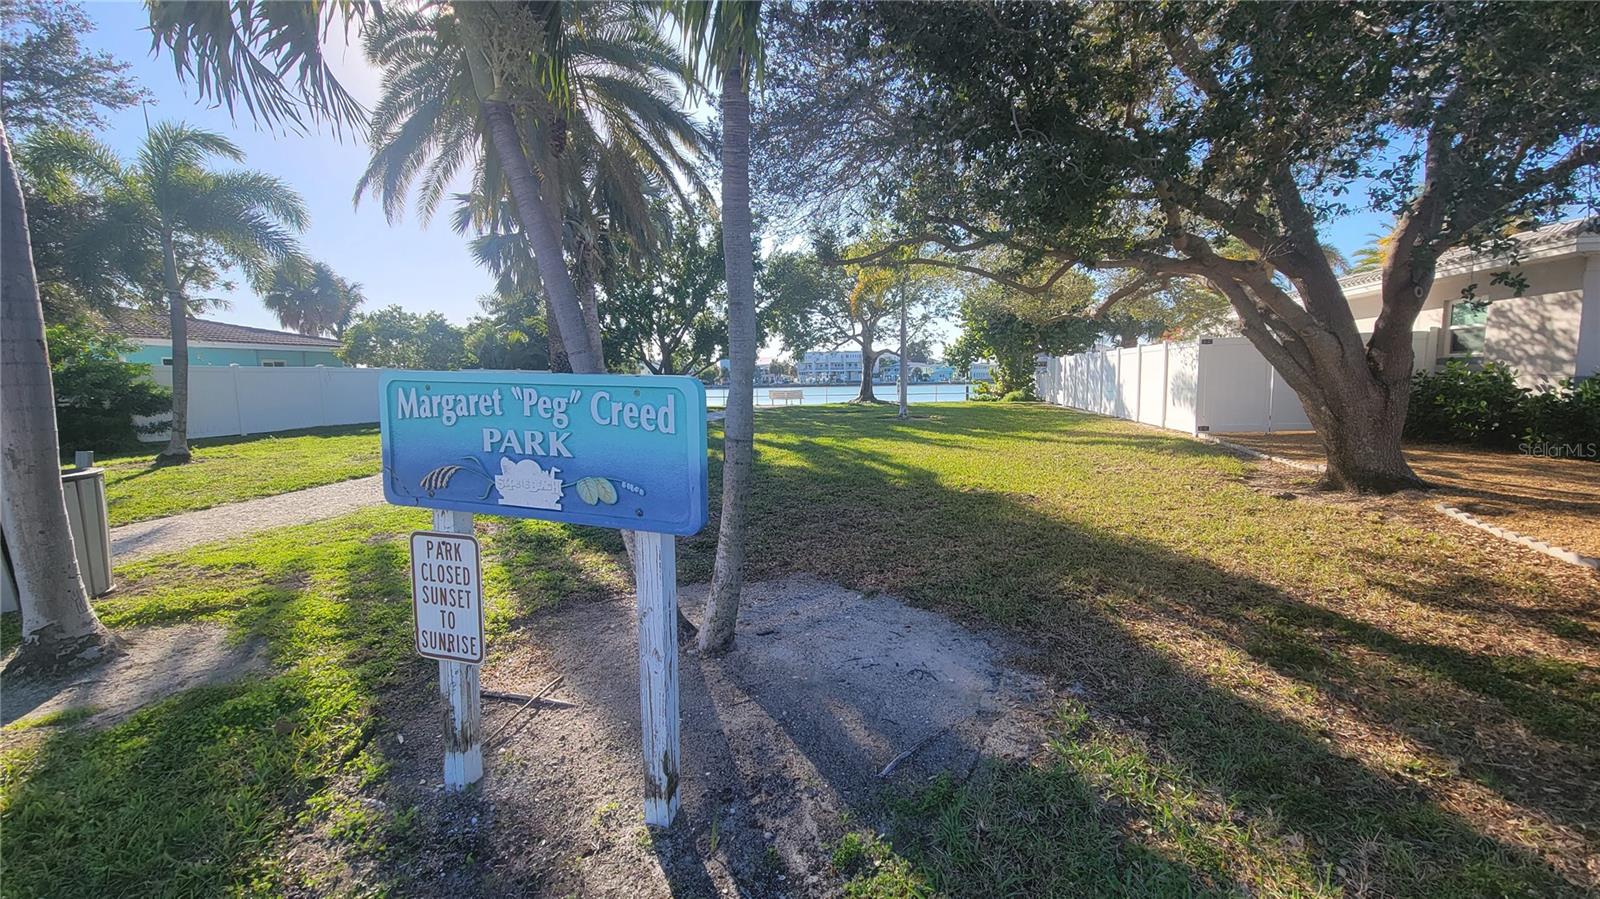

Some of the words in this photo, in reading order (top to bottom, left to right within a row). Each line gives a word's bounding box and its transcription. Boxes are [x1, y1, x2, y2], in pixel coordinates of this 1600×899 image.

[397, 386, 504, 426] Margaret
[590, 391, 676, 434] Creed
[482, 428, 574, 458] PARK
[426, 540, 462, 562] PARK
[421, 562, 470, 586] CLOSED
[422, 585, 471, 609] SUNSET
[440, 609, 455, 630] TO
[421, 630, 477, 656] SUNRISE
